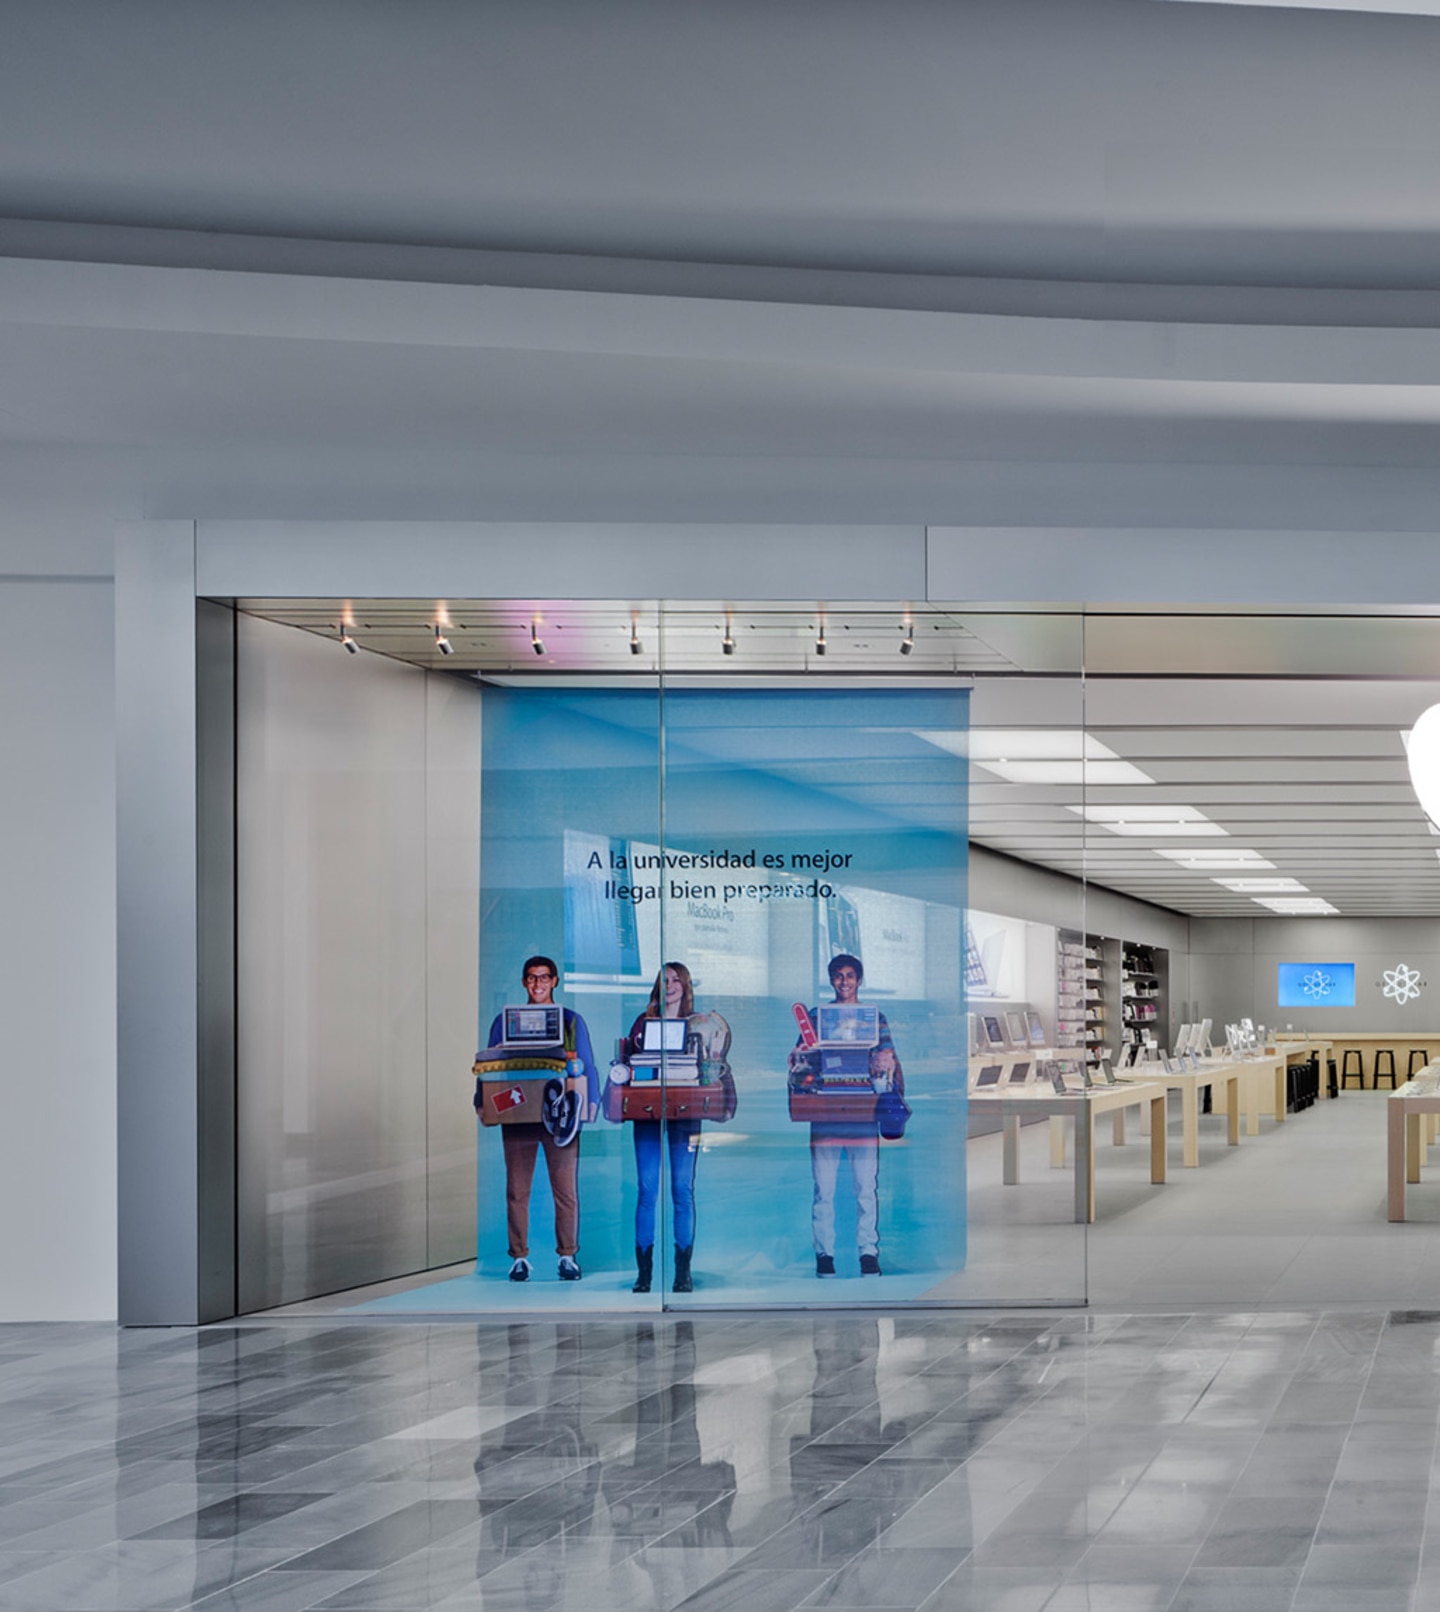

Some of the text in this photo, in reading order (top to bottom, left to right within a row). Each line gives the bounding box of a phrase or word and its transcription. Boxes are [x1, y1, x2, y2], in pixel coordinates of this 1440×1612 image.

[587, 849, 852, 873] A la universidad es mejor
[671, 880, 716, 899] bien
[723, 879, 837, 903] preparado.
